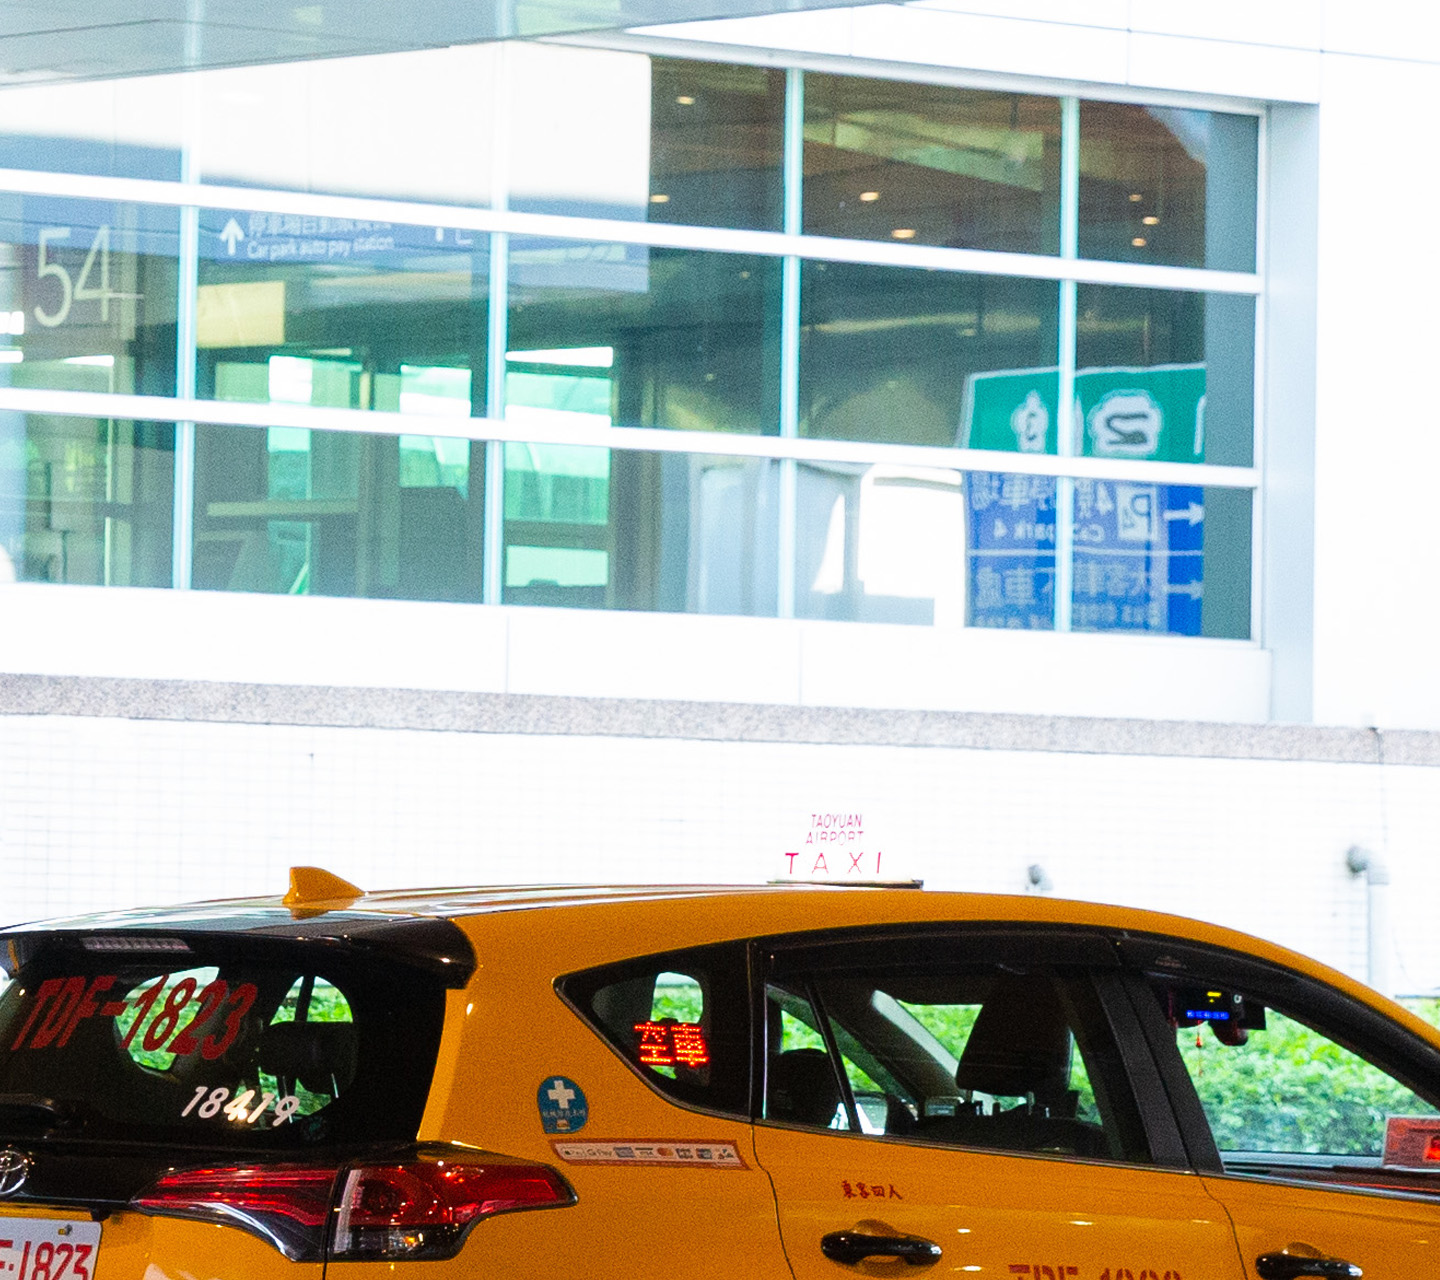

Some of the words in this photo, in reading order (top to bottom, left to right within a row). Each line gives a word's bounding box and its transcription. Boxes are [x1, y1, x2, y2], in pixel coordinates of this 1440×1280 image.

[34, 224, 138, 327] 54
[806, 830, 864, 846] AIRPORT
[811, 813, 863, 829] TAOYUAN
[784, 851, 882, 875] TAXI
[10, 973, 258, 1060] TDF-1823
[633, 1021, 709, 1067] 空車
[181, 1085, 300, 1127] 18419
